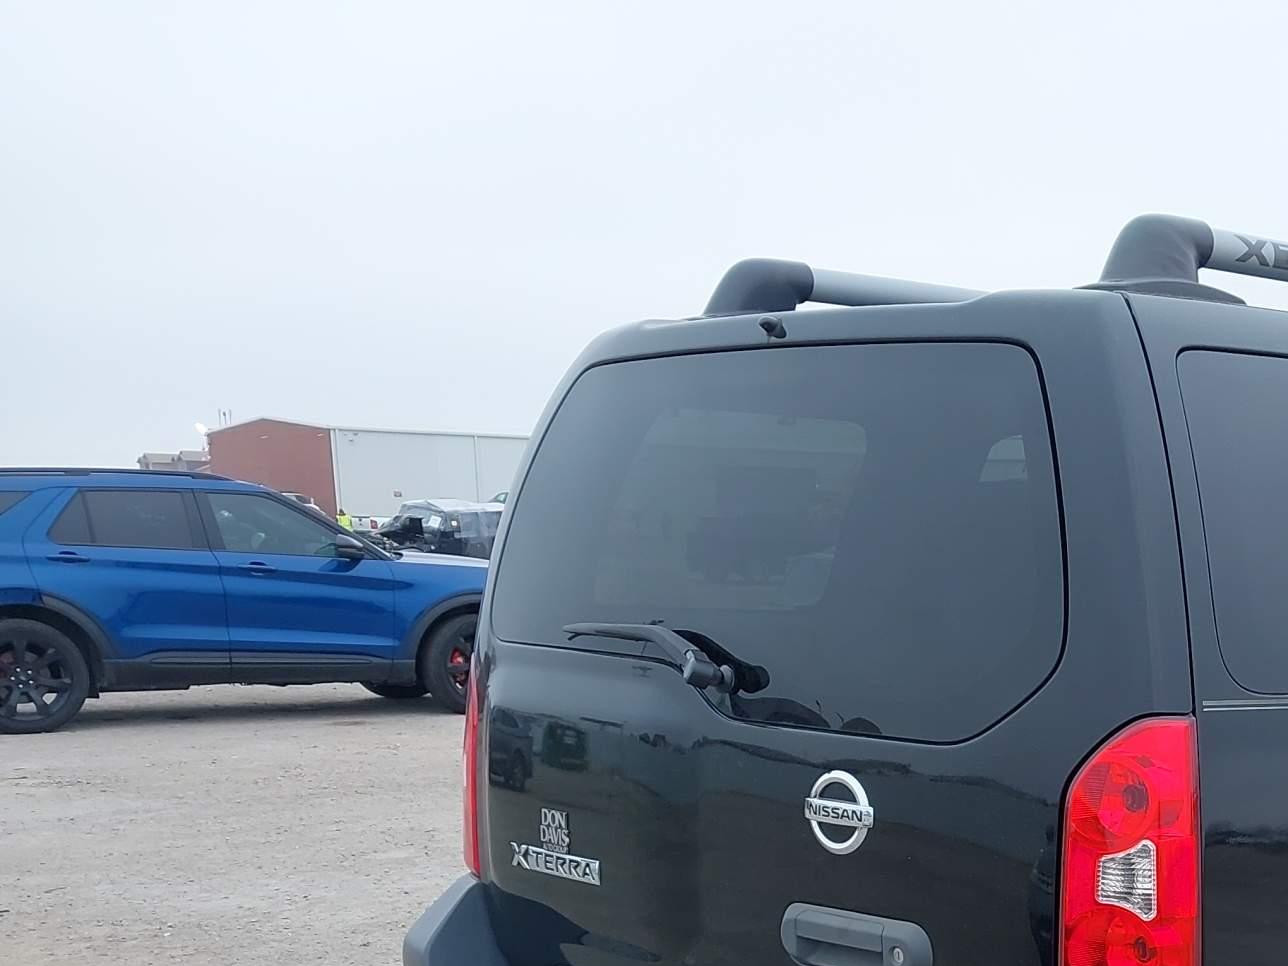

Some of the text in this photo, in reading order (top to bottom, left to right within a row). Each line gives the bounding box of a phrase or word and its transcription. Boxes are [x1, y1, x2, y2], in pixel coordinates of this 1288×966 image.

[541, 808, 568, 828] DON
[807, 800, 863, 822] NISSAN
[540, 825, 570, 847] DAVIS
[510, 841, 598, 883] XTERRA
